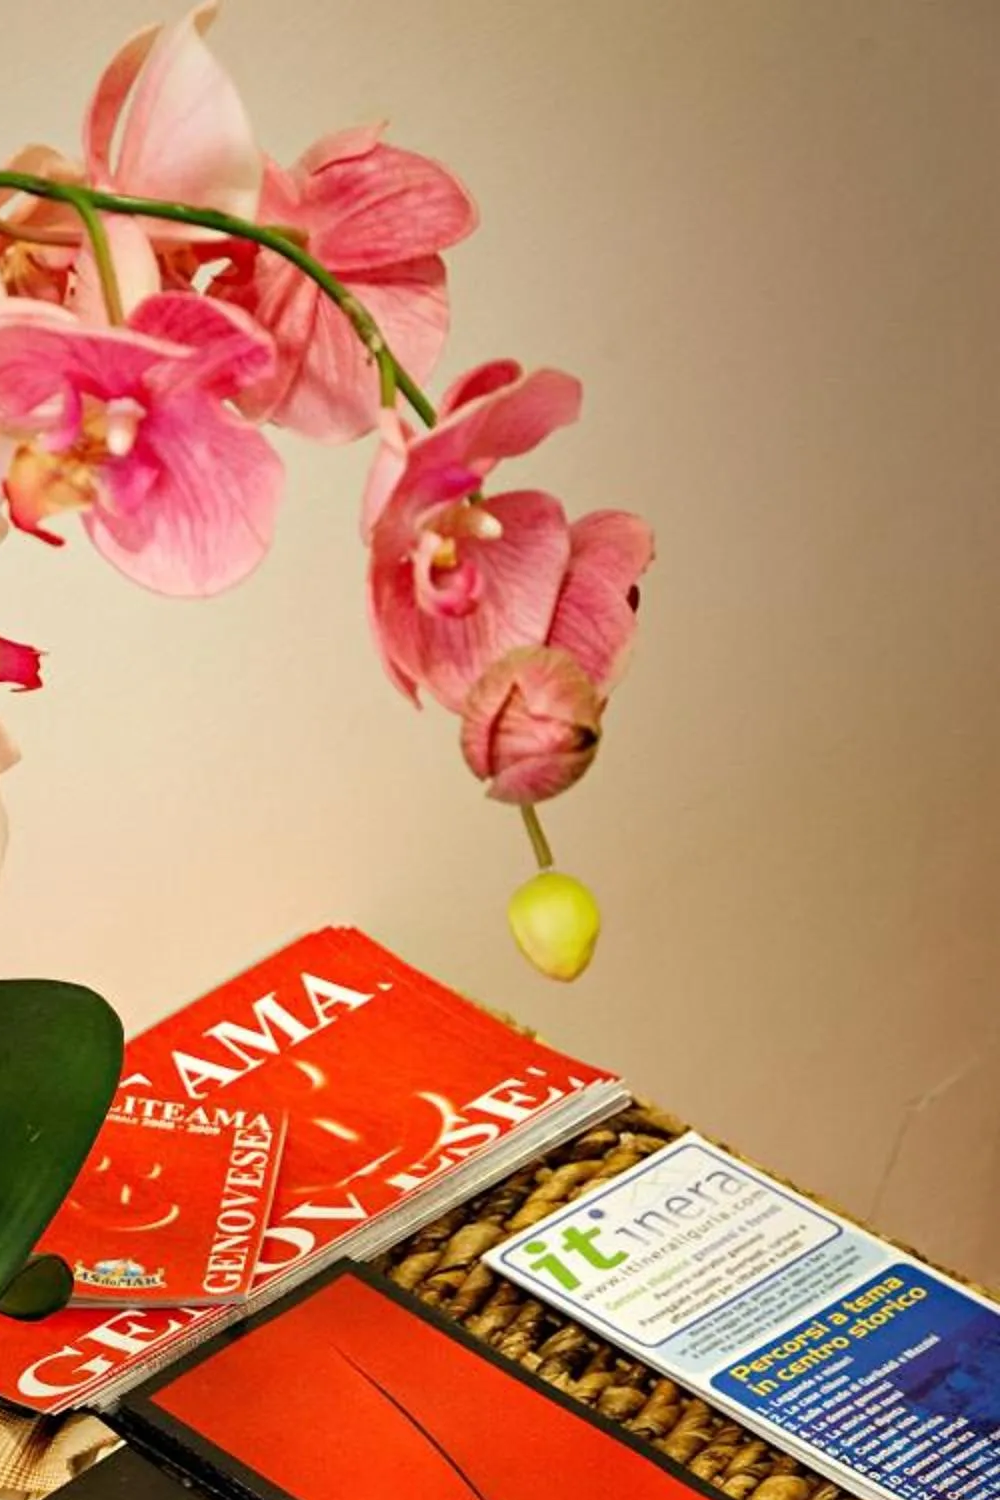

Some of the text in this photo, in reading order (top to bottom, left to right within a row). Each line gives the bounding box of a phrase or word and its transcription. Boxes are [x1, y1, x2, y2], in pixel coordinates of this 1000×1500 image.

[202, 1120, 275, 1296] GENOVESE
[728, 1314, 833, 1387] Percorsi
[829, 1308, 850, 1328] a
[840, 1270, 905, 1318] tema
[747, 1373, 779, 1399] in
[774, 1327, 852, 1387] centro
[848, 1279, 930, 1342] storico
